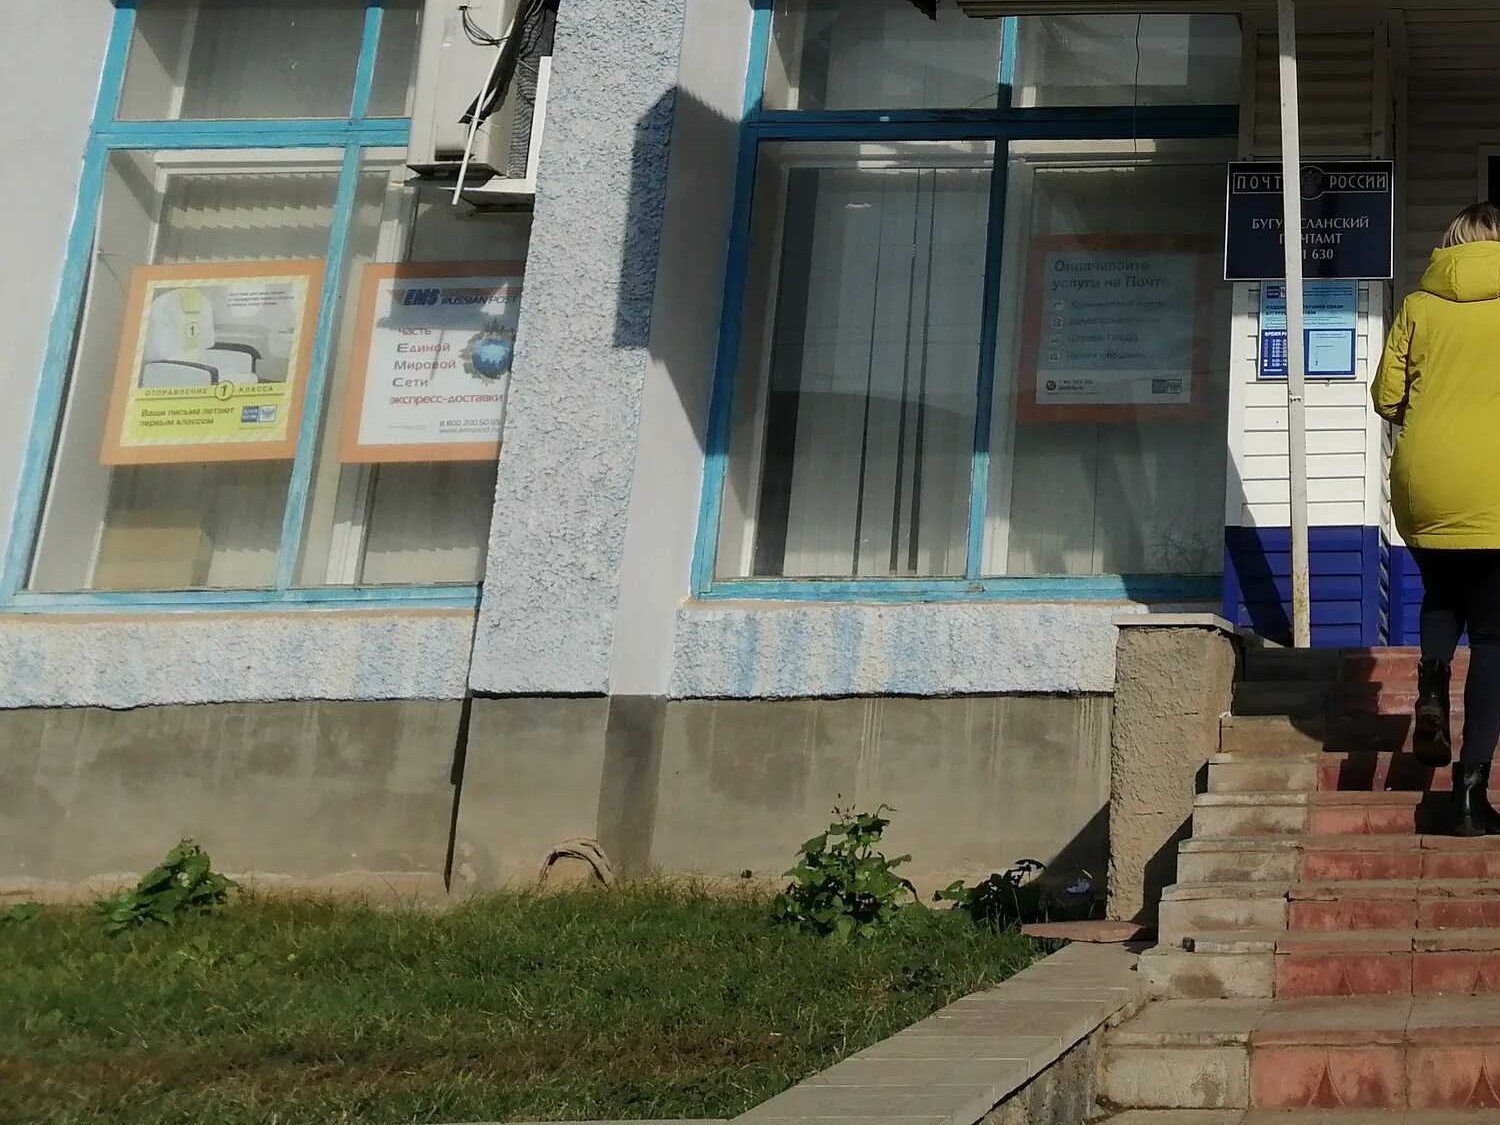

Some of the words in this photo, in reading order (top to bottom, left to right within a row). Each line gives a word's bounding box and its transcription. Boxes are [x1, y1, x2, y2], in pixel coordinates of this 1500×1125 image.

[1237, 176, 1283, 190] ПОЧТ
[1330, 175, 1386, 189] РОССИИ
[1252, 215, 1369, 230] БУГУСЛАНСКИЙ
[1279, 233, 1342, 244] ПЧТАМТ
[1312, 249, 1334, 260] 630
[1054, 260, 1150, 273] Оплачивайте
[1104, 279, 1121, 288] на
[403, 288, 440, 306] EMS
[441, 295, 486, 306] RUSSIAN
[488, 295, 517, 305] POST
[397, 342, 450, 353] Единой
[394, 360, 456, 372] Мировой
[392, 377, 429, 388] Сети
[144, 387, 207, 397] ОТПРАВЛЕНИЕ
[239, 385, 273, 393] КЛАССА
[389, 393, 503, 406] экспресс-доставки
[167, 408, 200, 417] письма
[176, 417, 214, 426] классом
